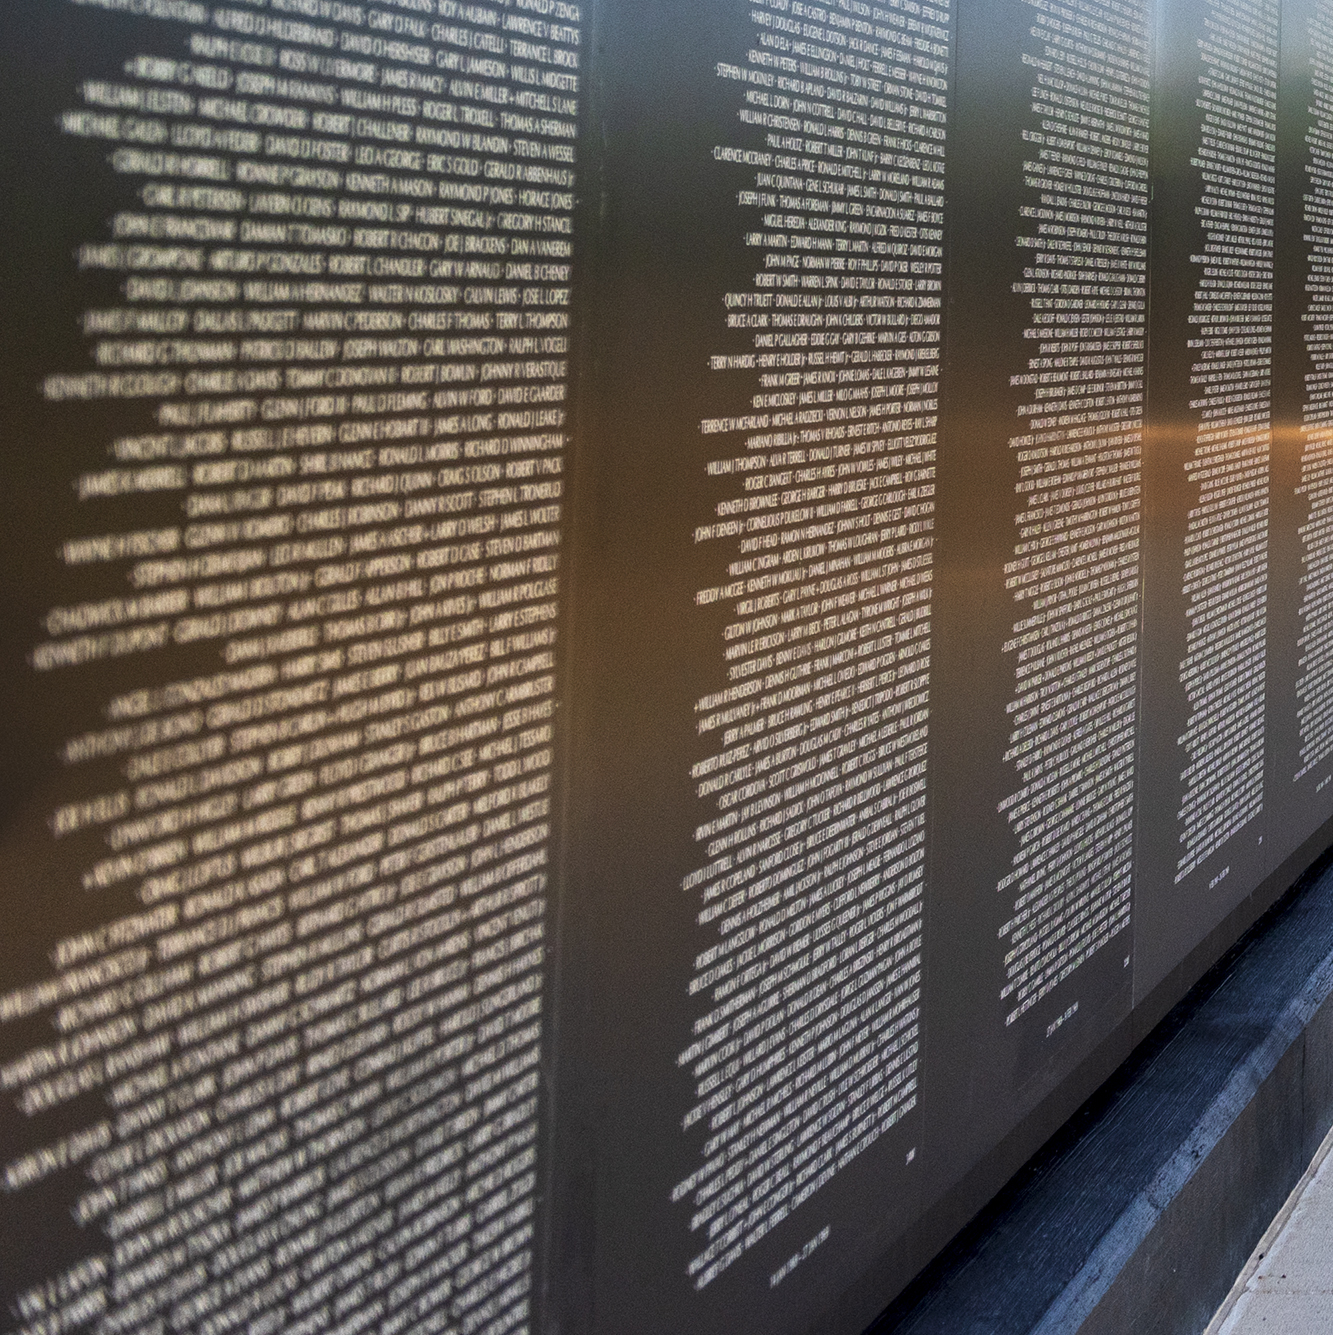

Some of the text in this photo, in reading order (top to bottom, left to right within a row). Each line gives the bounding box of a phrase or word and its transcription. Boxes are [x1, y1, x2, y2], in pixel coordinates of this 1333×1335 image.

[555, 2, 579, 22] ZENGA
[751, 9, 771, 27] HARVEY
[775, 15, 800, 35] DOUGLAS
[501, 14, 542, 37] LAWRENCE
[509, 40, 546, 62] TERRANCE
[552, 49, 577, 68] BROCK
[748, 48, 773, 67] KENNETH
[779, 56, 796, 72] PETERS
[465, 57, 505, 81] JAMIESON
[510, 65, 535, 84] WILLIS
[540, 71, 577, 92] MIDGETTE
[716, 62, 741, 80] STEPHEN
[747, 69, 773, 87] MCKINLEY
[448, 80, 473, 99] ALVIN
[479, 85, 508, 104] MILLER
[515, 91, 551, 111] MITCHELL
[557, 98, 576, 115] LANE
[746, 89, 769, 106] MICHAEL
[772, 95, 789, 110] DORN
[500, 112, 533, 131] THOMAS
[540, 118, 575, 137] SHERMAN
[739, 108, 762, 125] WILLIAM
[766, 113, 800, 132] CHRISTENSEN
[513, 140, 541, 158] STEVEN
[547, 145, 574, 162] WESSEL
[713, 145, 741, 162] CLARENCE
[774, 155, 797, 170] CHARLES
[801, 159, 814, 173] PRICE
[426, 154, 445, 172] ERIC
[452, 157, 478, 175] GOLD
[483, 161, 515, 179] GERALD
[438, 182, 482, 201] RAYMOND
[489, 187, 513, 206] JONES
[518, 190, 550, 207] HORACE
[550, 193, 572, 211] JONES
[496, 213, 533, 230] GREGORY
[745, 232, 762, 246] LARRY
[767, 234, 787, 248] MARTIN
[790, 236, 811, 249] EDWARD
[816, 238, 832, 251] MANN
[464, 262, 500, 278] ARNAUD
[505, 263, 532, 279] DANIEL
[540, 265, 569, 280] CHENEY
[463, 287, 493, 302] CALVIN
[493, 288, 517, 303] LEWIS
[522, 289, 539, 305] JOSE
[544, 289, 568, 304] LOPEZ
[495, 313, 518, 328] TERRY
[523, 313, 567, 328] THOMPSON
[727, 314, 745, 327] BRUCE
[750, 314, 767, 327] CLARK
[771, 315, 793, 327] THOMAS
[754, 334, 773, 347] DANIEL
[778, 334, 807, 346] GALLAGHER
[758, 354, 775, 367] HENRY
[779, 353, 801, 366] HOLDER
[707, 460, 731, 475] WILLIAM
[734, 456, 765, 472] THOMPSON
[717, 500, 743, 516] KENNETH
[748, 494, 777, 511] BROWNLEE
[740, 538, 758, 553] DAVID
[761, 534, 777, 549] HEAD
[696, 587, 719, 605] FREDDY
[724, 581, 743, 598] MCGEE
[729, 655, 772, 680] SYLVESTER DAVIS
